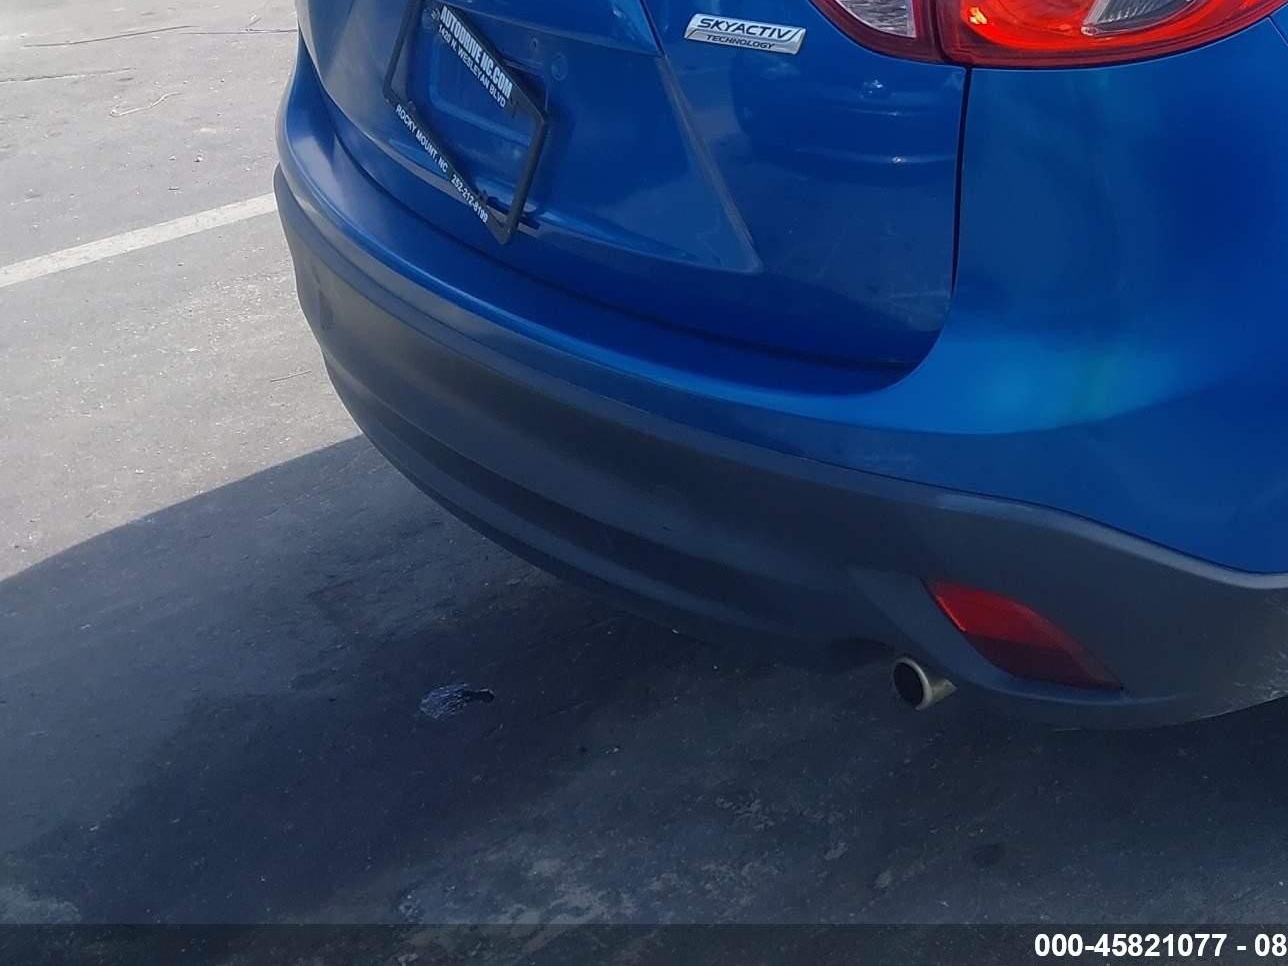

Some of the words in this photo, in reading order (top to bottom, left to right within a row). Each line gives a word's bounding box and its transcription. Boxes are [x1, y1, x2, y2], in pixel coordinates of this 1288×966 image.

[440, 4, 482, 64] AUTODRIVE
[480, 51, 513, 99] NC.COM
[697, 18, 792, 39] SKYACTIV
[706, 34, 776, 50] TECHNOLOGY
[457, 45, 490, 90] WESLEYAN
[489, 83, 506, 108] BLVD
[395, 104, 417, 133] ROCKY
[415, 129, 438, 163] MOUNT,
[438, 156, 449, 173] NC
